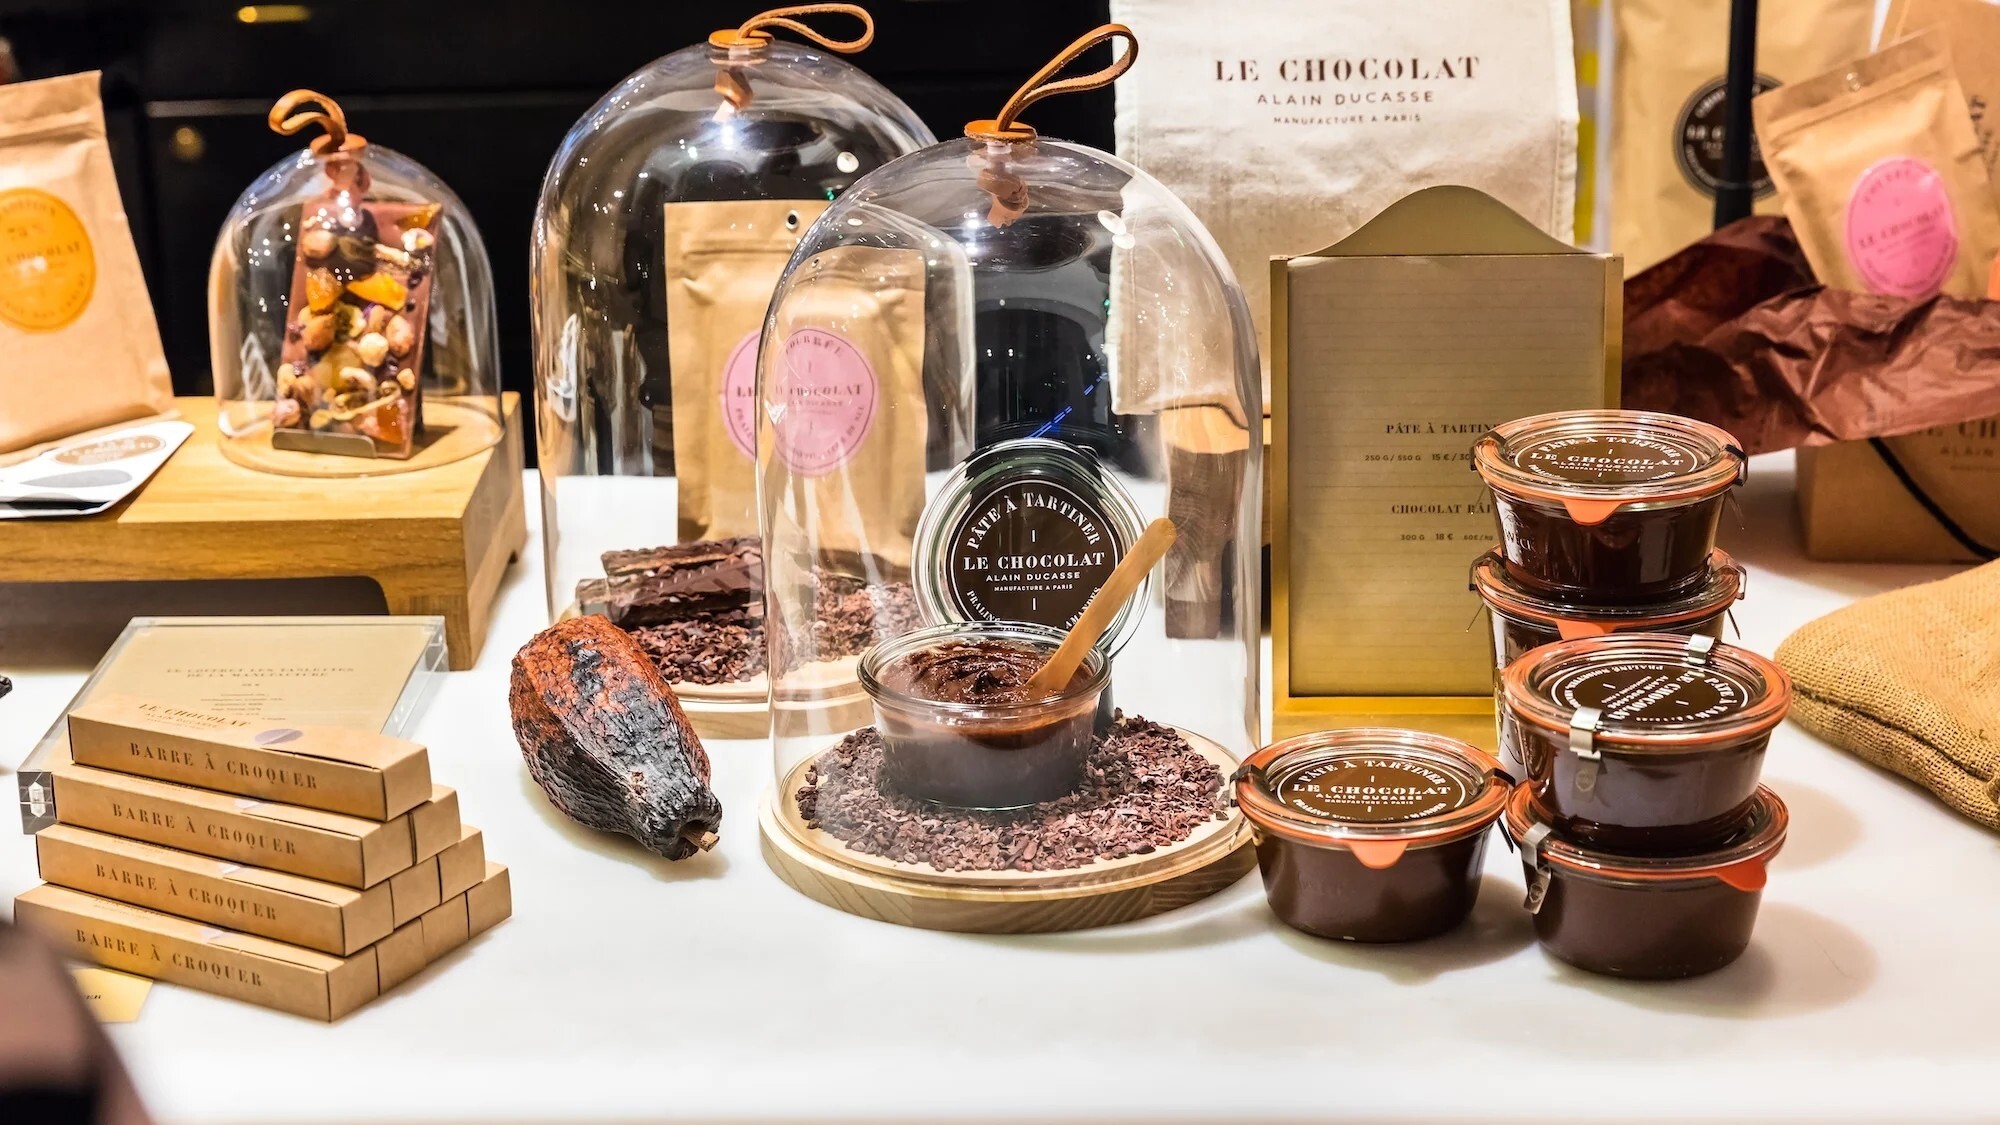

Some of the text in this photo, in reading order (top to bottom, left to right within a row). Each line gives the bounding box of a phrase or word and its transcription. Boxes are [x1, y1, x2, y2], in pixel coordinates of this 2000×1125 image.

[1215, 56, 1480, 82] LE CHOCOLAT
[1257, 91, 1434, 106] ALAIN DUCASSE
[1274, 114, 1364, 125] MANUFACTURE
[1384, 113, 1422, 122] PARIS
[1386, 422, 1500, 434] PÂTE À TARTIN
[1538, 438, 1577, 453] PÂTE
[1605, 437, 1682, 459] TARTINER
[1530, 452, 1684, 467] LE CHOCOLAT
[1391, 504, 1461, 514] CHOCOLAT
[967, 491, 1101, 550] PÂTE À TARTINER
[963, 551, 1105, 571] LE CHOCOLAT
[985, 571, 1081, 582] ALAIN DUCASSE
[1052, 583, 1073, 591] PARIS
[165, 709, 251, 727] CHOCOLAT
[130, 742, 318, 789] BARRE À CROQUER
[1299, 764, 1338, 783] PÂTE
[1364, 760, 1447, 785] TARTINER
[1292, 784, 1451, 795] LE CHOCOLAT
[113, 803, 297, 855] BARRE À CROQUER
[96, 863, 277, 921] BARRE À CROQUER
[77, 929, 263, 987] BARRE À CROQUER
